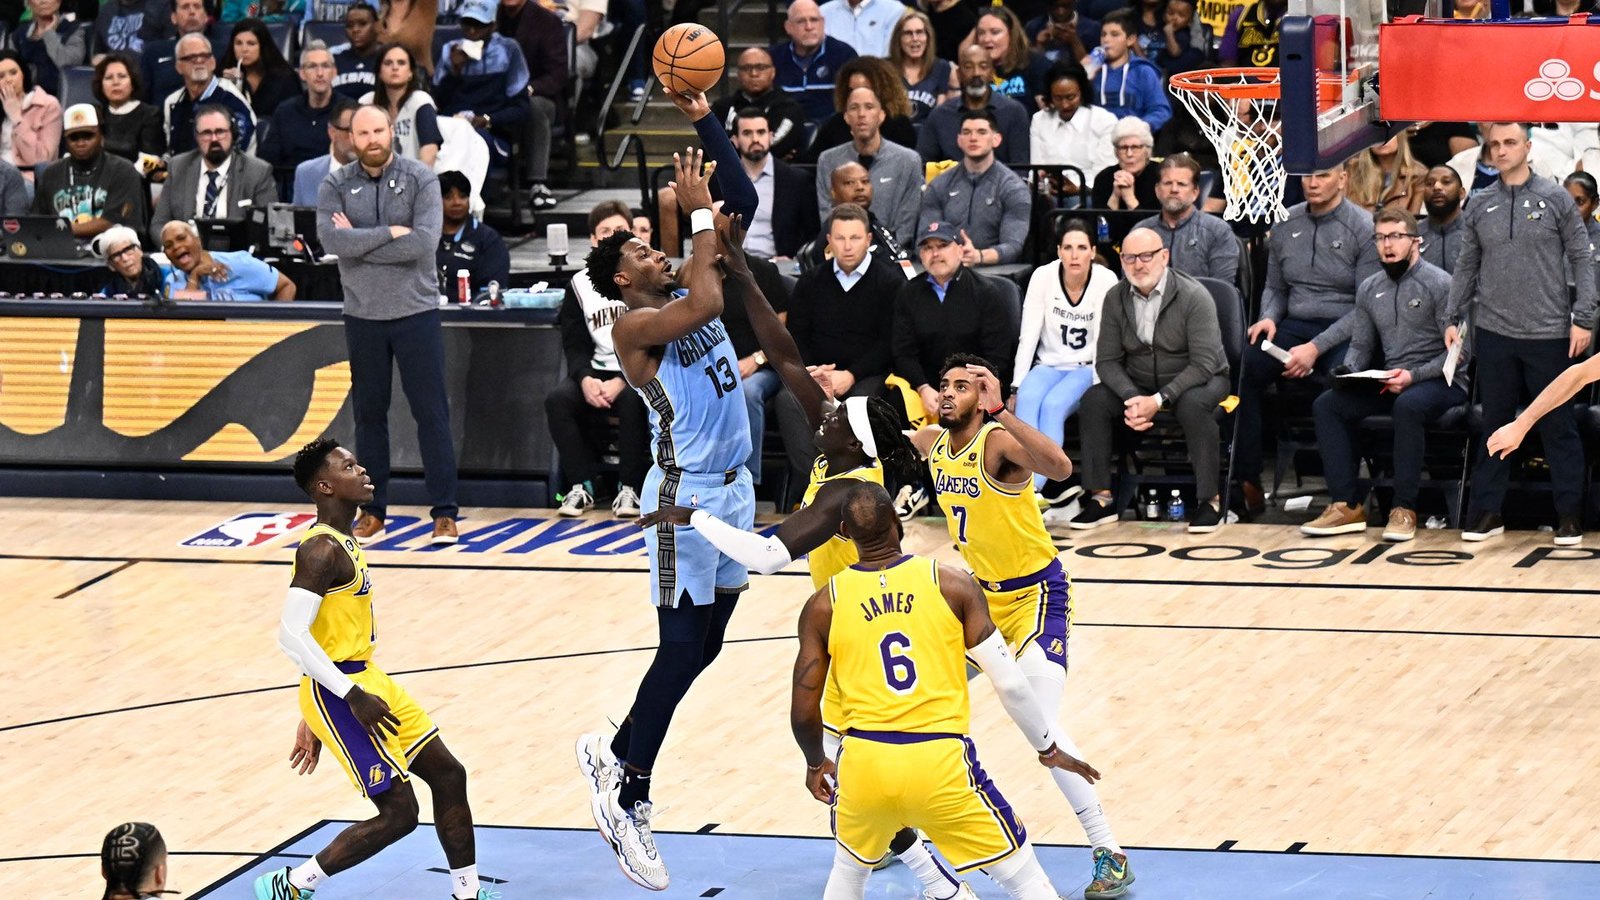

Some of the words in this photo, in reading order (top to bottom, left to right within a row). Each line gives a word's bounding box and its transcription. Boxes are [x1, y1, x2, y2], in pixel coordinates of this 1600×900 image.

[1053, 306, 1094, 321] MEMPHIS
[1060, 324, 1088, 350] 13
[704, 356, 737, 399] 13
[935, 467, 981, 498] LAKERS
[951, 505, 968, 544] 7
[1046, 535, 1475, 570] oogle
[860, 592, 914, 621] JAMES
[878, 631, 918, 694] 6
